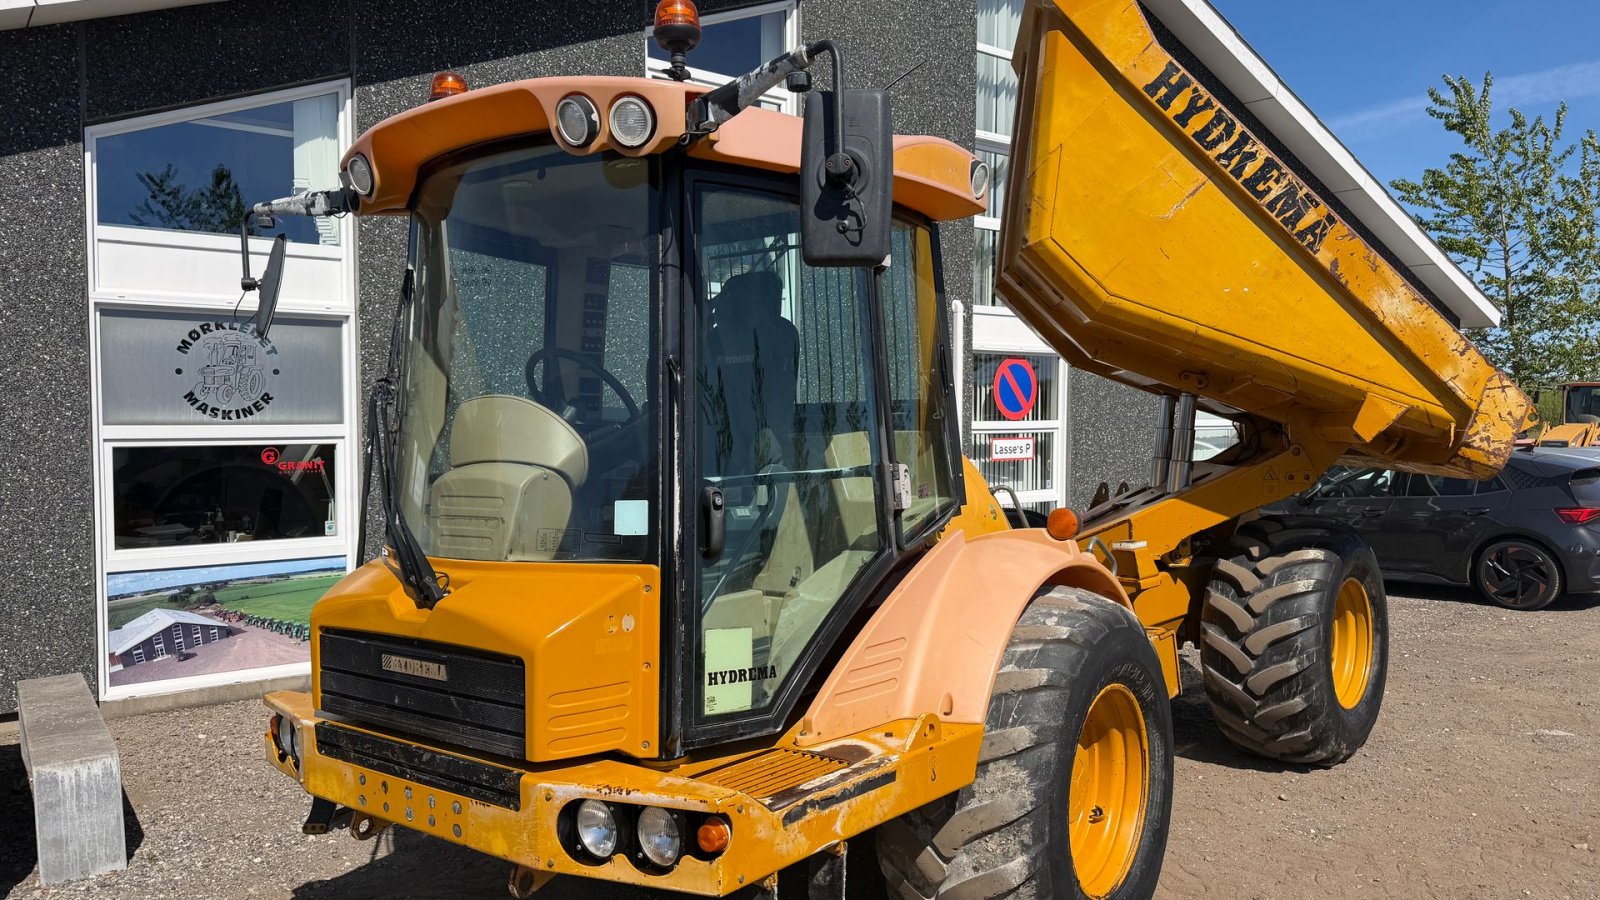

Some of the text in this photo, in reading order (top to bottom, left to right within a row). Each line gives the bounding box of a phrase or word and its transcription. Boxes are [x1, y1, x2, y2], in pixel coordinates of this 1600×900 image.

[1142, 60, 1338, 255] HYDREMA
[183, 390, 274, 421] MASKINER
[994, 443, 1031, 455] Lasse's P
[278, 460, 325, 470] GRANIT
[708, 665, 777, 687] HYDREMA
